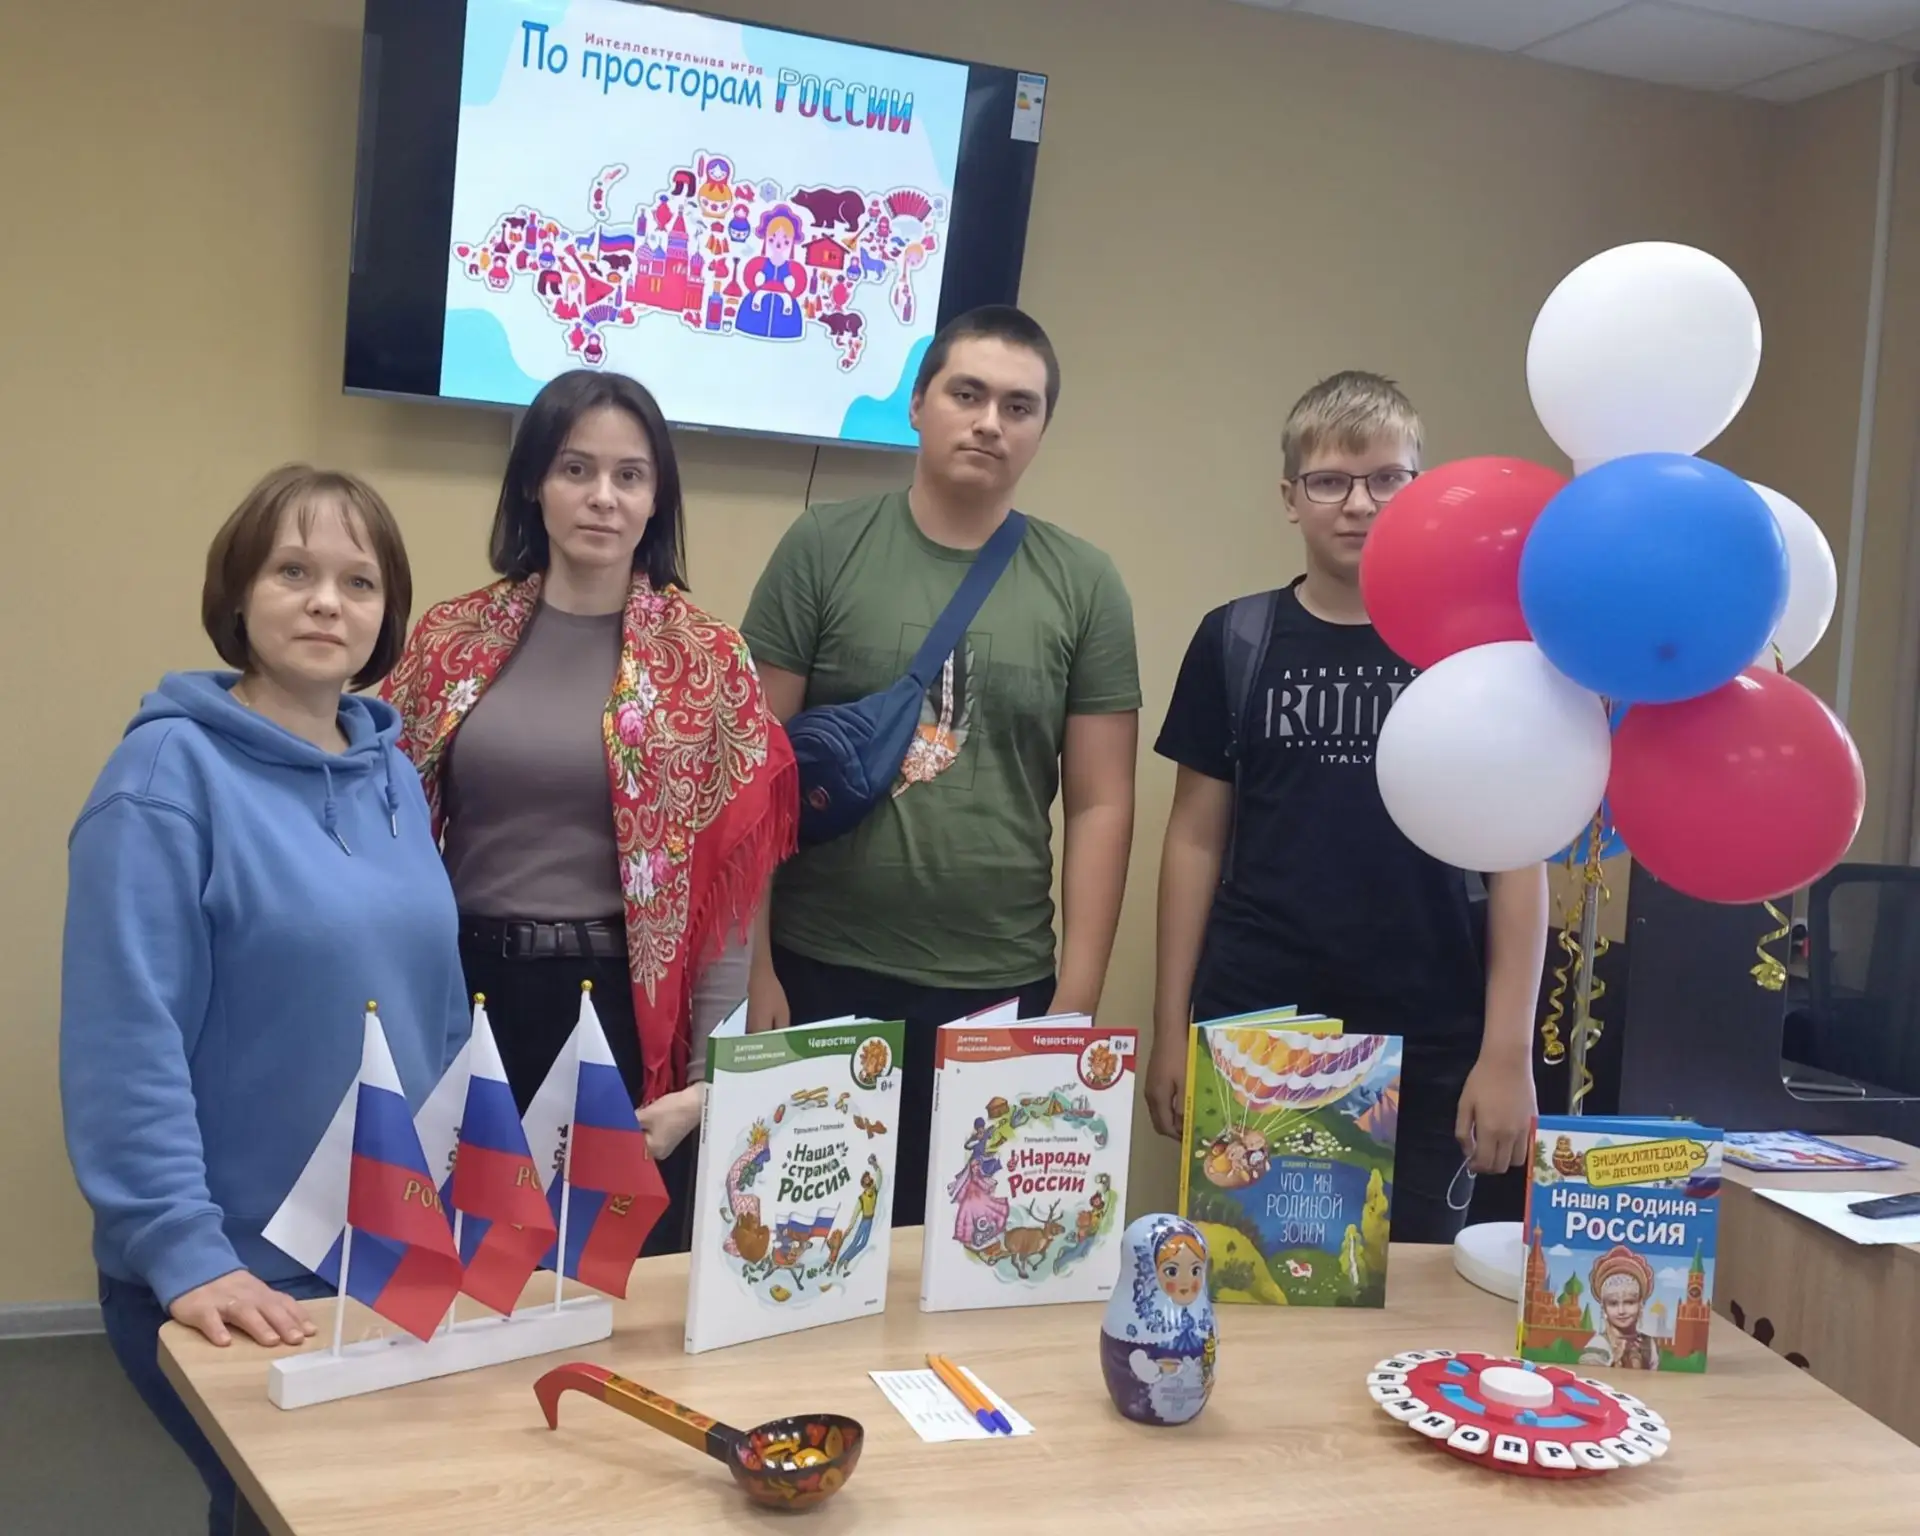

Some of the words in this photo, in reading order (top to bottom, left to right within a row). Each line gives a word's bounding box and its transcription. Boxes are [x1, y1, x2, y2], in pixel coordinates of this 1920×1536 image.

[585, 32, 725, 68] Интеллектуальная
[731, 61, 764, 76] игра
[522, 20, 568, 74] По
[582, 50, 762, 111] просторам
[775, 67, 914, 135] РОССИИ
[1320, 755, 1373, 764] ITALY
[793, 1143, 835, 1162] Наша
[1020, 1148, 1091, 1174] Народы
[1592, 1144, 1688, 1168] ЭНЦИКЛОПЕДИЯ
[788, 1158, 840, 1184] страна
[1613, 1163, 1660, 1179] ДЕТСКОГО
[1663, 1160, 1689, 1172] САДА
[777, 1166, 851, 1203] Россия
[1008, 1174, 1085, 1198] России
[1266, 1193, 1343, 1220] РОДИНОЙ
